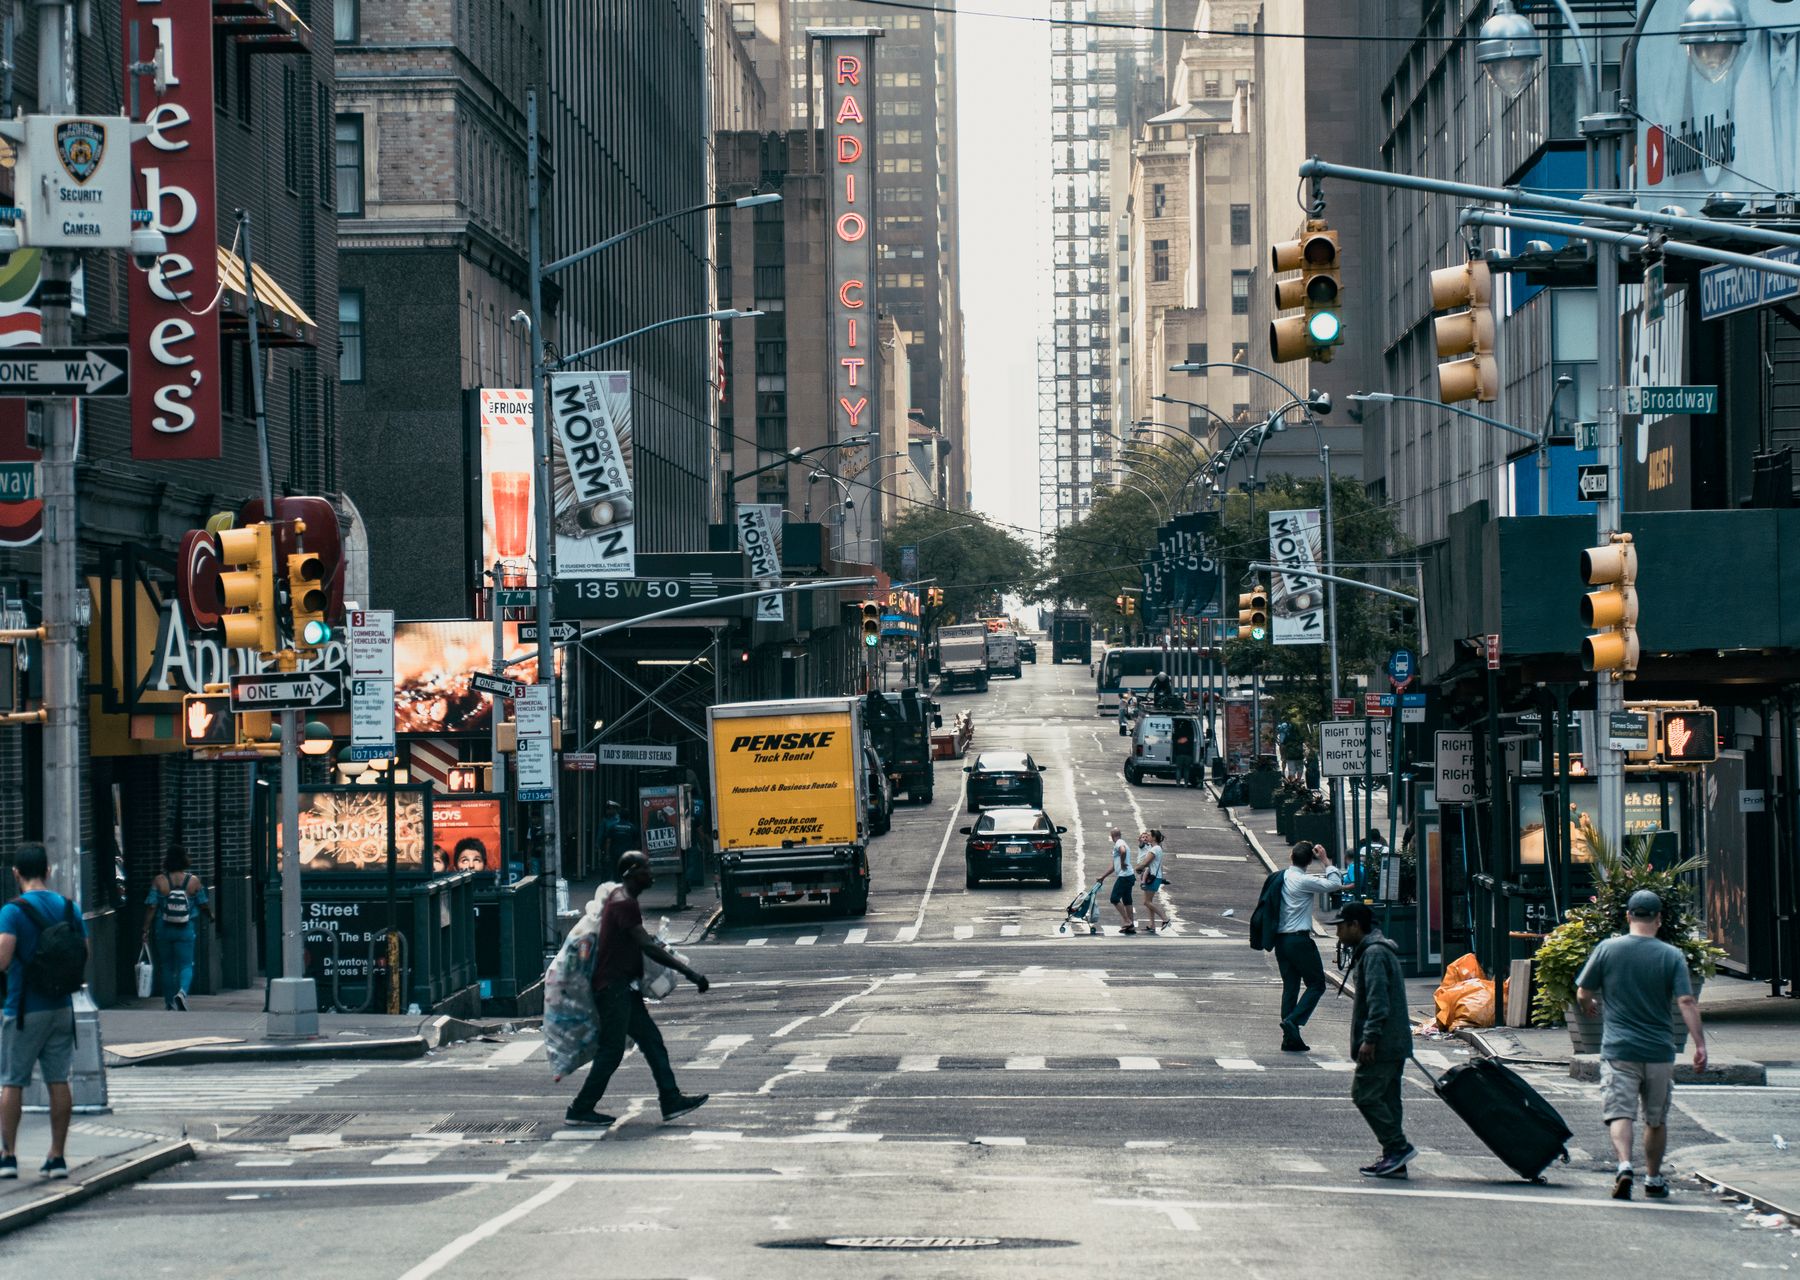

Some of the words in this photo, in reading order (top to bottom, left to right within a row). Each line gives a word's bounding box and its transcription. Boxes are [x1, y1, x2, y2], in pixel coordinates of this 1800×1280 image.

[836, 55, 865, 242] RADIO
[1666, 118, 1704, 177] YouTube
[1705, 110, 1736, 169] Music
[137, 0, 201, 433] lebee's
[1703, 266, 1758, 313] OUTFRONT
[840, 279, 867, 426] CITY
[0, 363, 38, 381] ONE
[65, 363, 107, 382] WAY
[1642, 388, 1714, 413] Broadway
[495, 402, 534, 415] FRIDAYS
[582, 381, 600, 413] THE
[592, 416, 616, 464] BOOK
[607, 465, 624, 489] OF
[760, 530, 773, 557] BOOK
[503, 592, 511, 605] 7
[354, 613, 363, 626] 3
[526, 628, 538, 638] ON
[553, 627, 572, 637] WAY
[247, 684, 279, 700] ONE
[292, 682, 325, 698] WAY
[354, 682, 363, 695] 6
[479, 679, 496, 690] ONE
[501, 682, 514, 692] WA
[517, 687, 525, 698] 3
[1324, 728, 1349, 738] RIGHT
[1354, 727, 1382, 736] TUNS
[1626, 722, 1643, 730] Square
[519, 740, 526, 750] 6
[730, 731, 835, 753] PENSKE
[1341, 739, 1367, 748] FROM
[1441, 740, 1473, 751] RIGHT
[603, 749, 621, 759] TAD'S
[621, 750, 648, 760] BROILED
[648, 750, 672, 761] STEAKS
[754, 753, 780, 763] Truck
[782, 751, 815, 762] Rental
[1326, 751, 1352, 760] RIGHT
[1342, 761, 1367, 770] ONLY
[1442, 770, 1475, 780] RIGHT
[732, 785, 770, 794] Household
[770, 784, 777, 792] &
[778, 783, 811, 792] Business
[811, 781, 838, 790] Rentals
[1462, 784, 1492, 794] ONY
[432, 810, 462, 821] BOYS
[758, 816, 818, 827] GoPenske.com
[646, 828, 675, 841] LIFE
[749, 824, 824, 836] 1-800-GO-PENSKE
[310, 903, 359, 916] Street
[301, 918, 339, 931] ation
[340, 932, 359, 942] The
